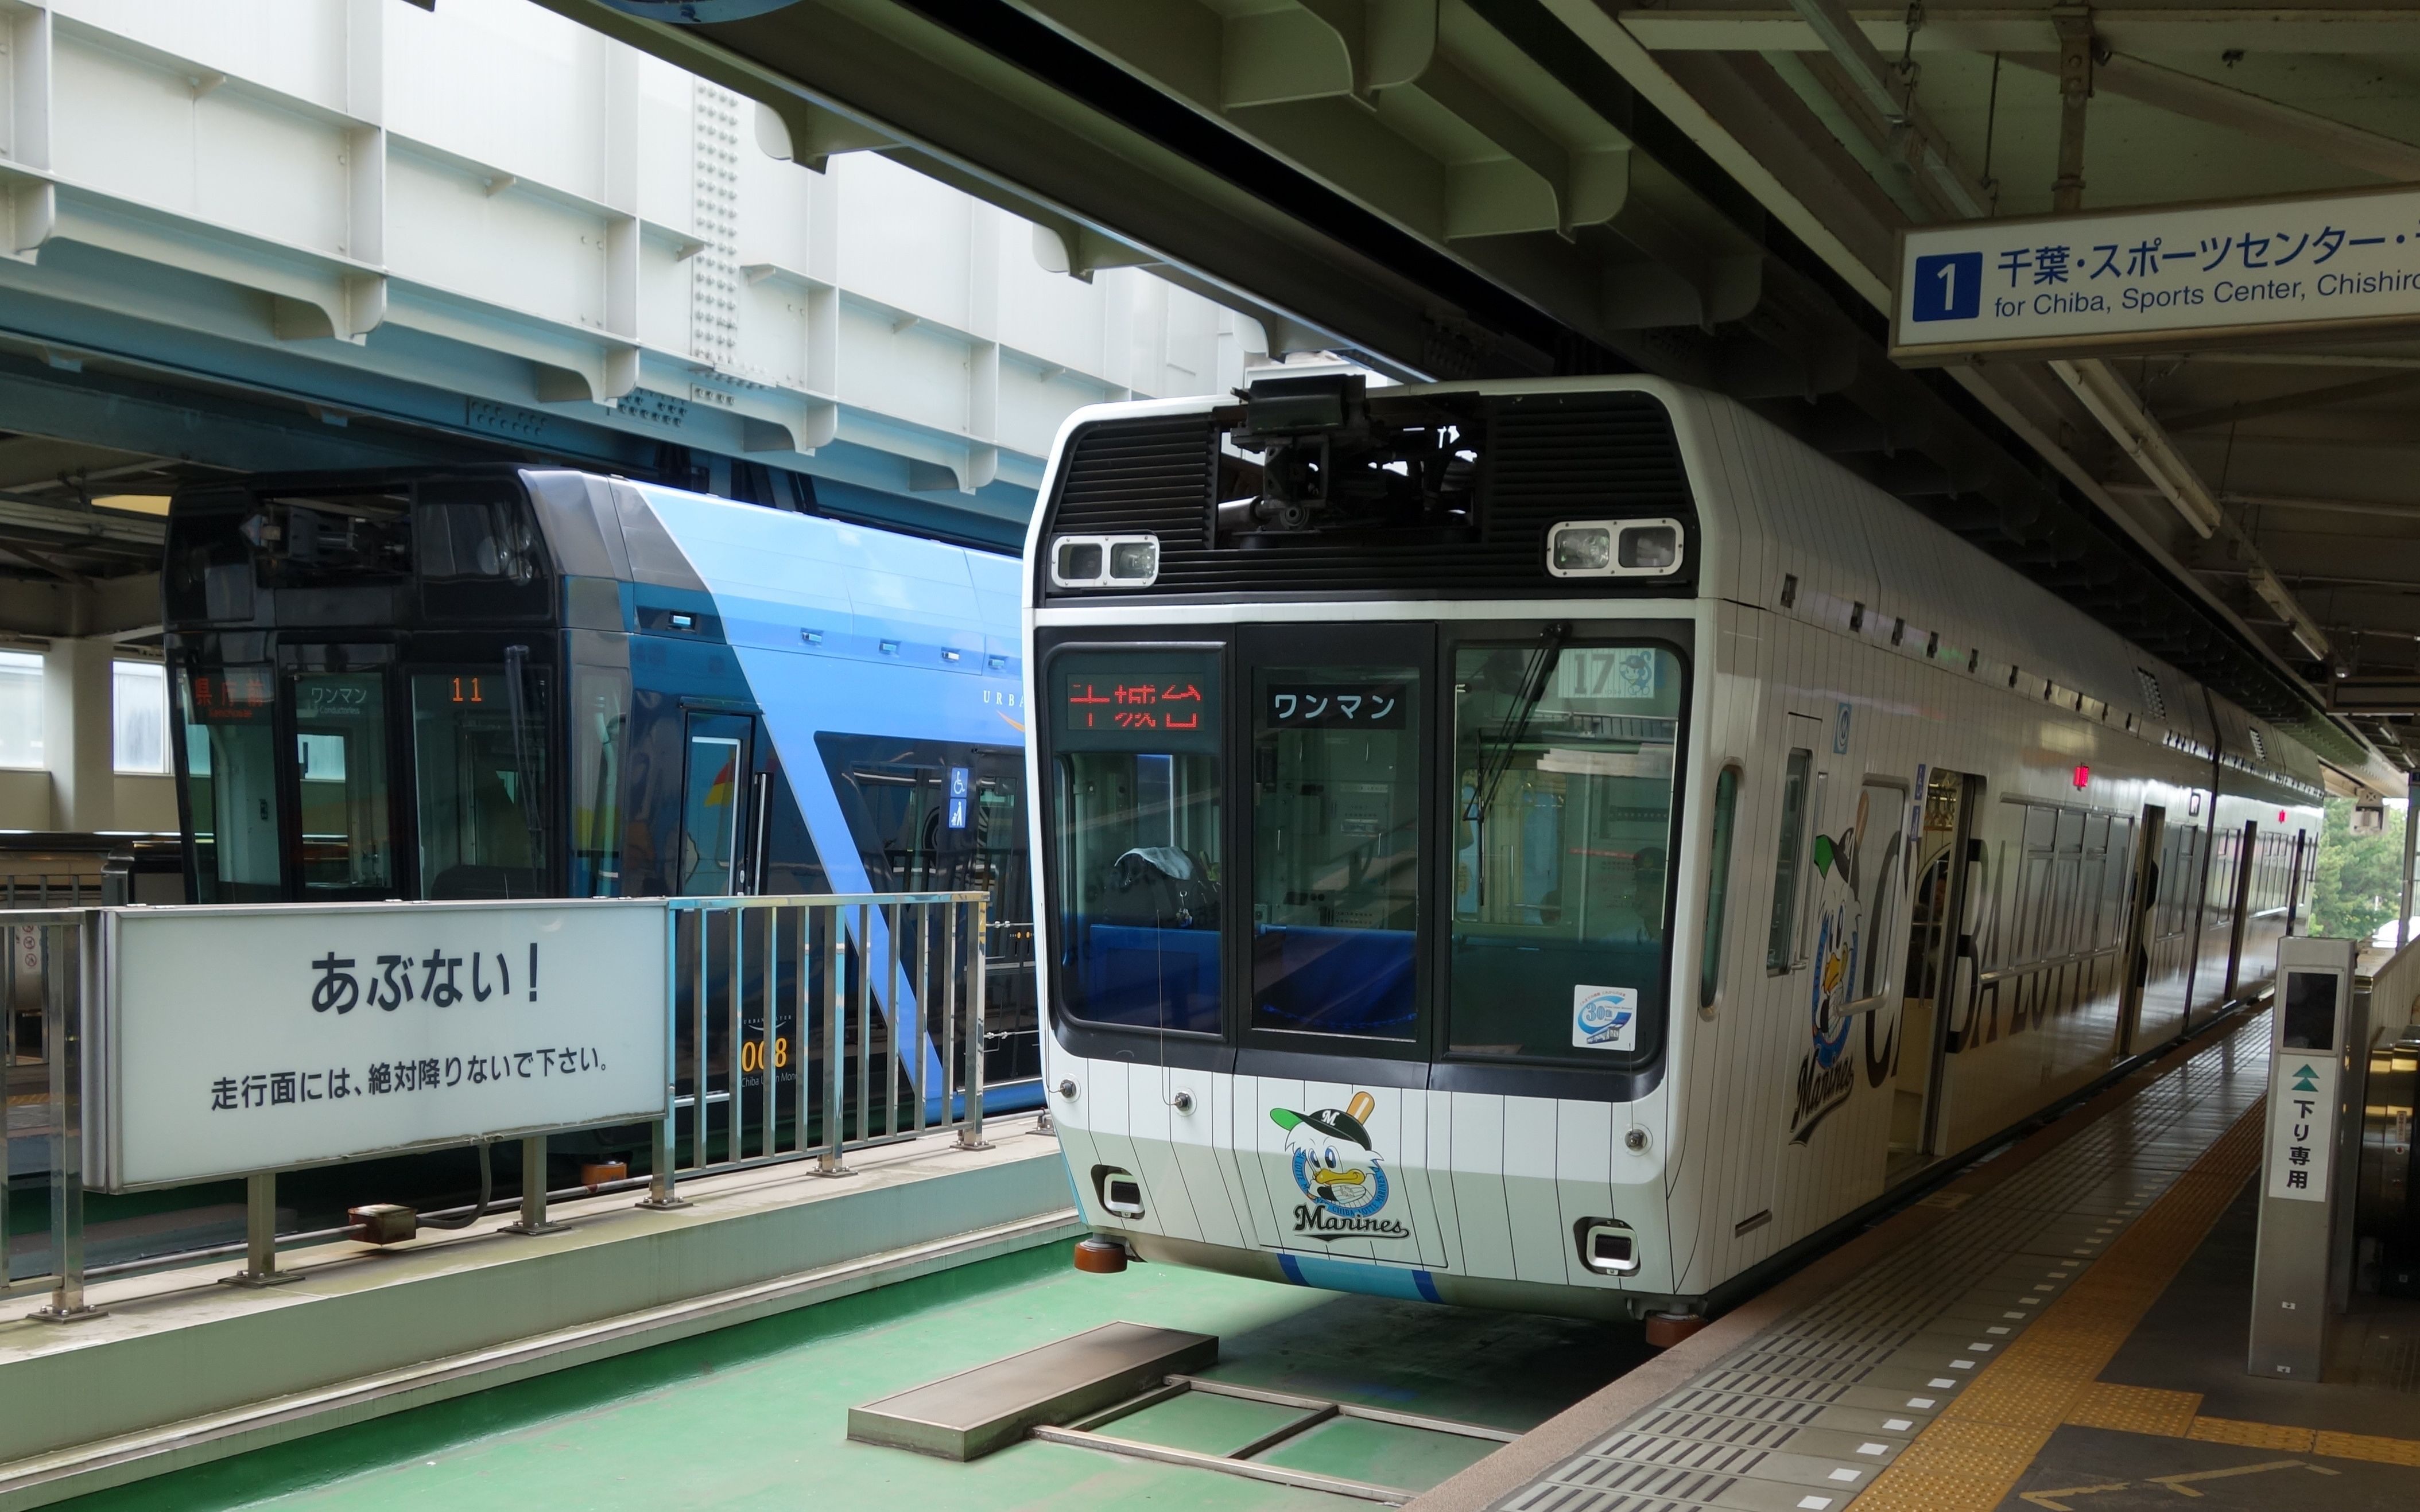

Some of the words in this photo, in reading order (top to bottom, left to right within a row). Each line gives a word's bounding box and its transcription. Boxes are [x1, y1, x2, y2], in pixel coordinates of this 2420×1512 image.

[1997, 220, 2420, 288] 千葉・スポーツセンター・
[1937, 262, 1957, 311] 1
[1995, 298, 2026, 318] for
[2033, 289, 2112, 317] Chiba,
[2121, 283, 2204, 313] Sports
[2214, 278, 2306, 305] Center,
[452, 677, 482, 702] 11
[1574, 653, 1615, 694] 17
[312, 687, 367, 704] ワンマン
[1274, 694, 1395, 720] ワンマン
[311, 943, 540, 1014] あぶない！
[211, 1046, 608, 1111] 走行面には、絶対降りないで下さい。
[1789, 1048, 1854, 1134] Marines
[1322, 1109, 1340, 1126] M
[2286, 1099, 2316, 1190] 下り専用
[1332, 1206, 1355, 1216] CHIBA
[1375, 1175, 1387, 1204] MARINES
[1293, 1203, 1410, 1237] Marines
